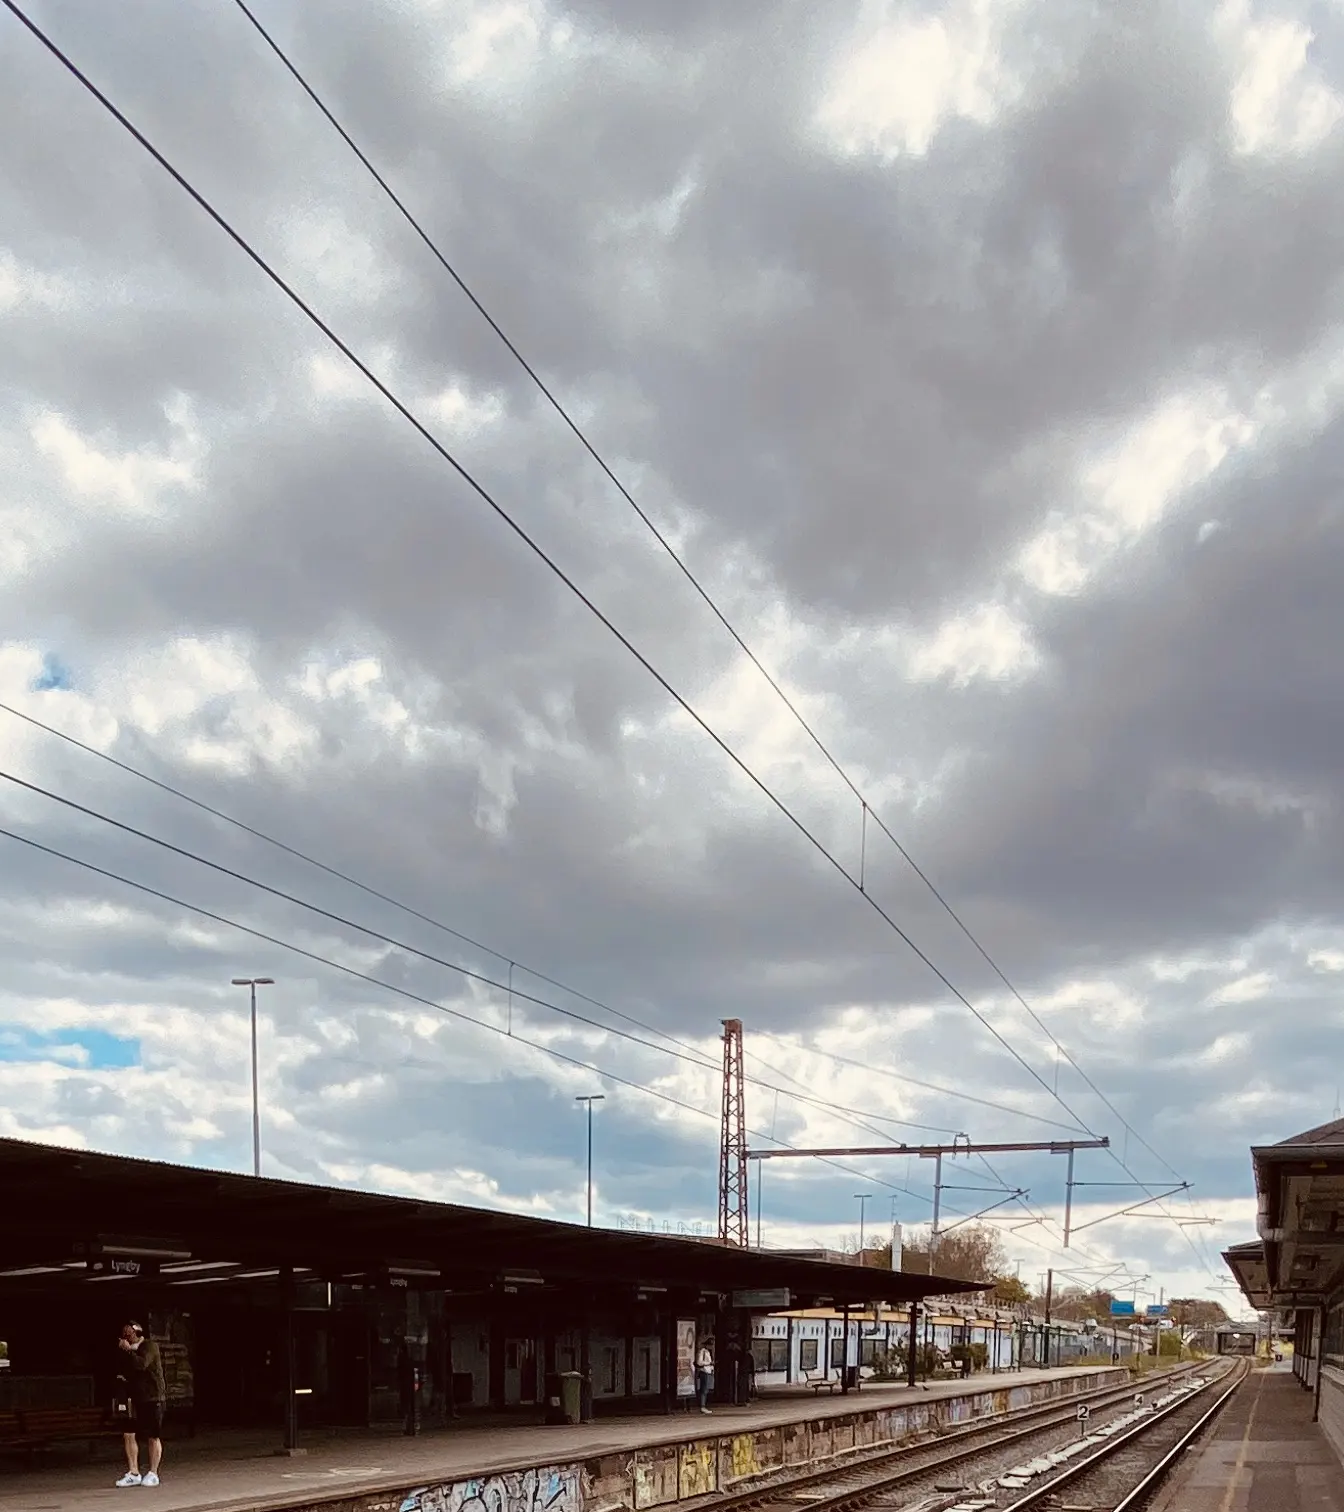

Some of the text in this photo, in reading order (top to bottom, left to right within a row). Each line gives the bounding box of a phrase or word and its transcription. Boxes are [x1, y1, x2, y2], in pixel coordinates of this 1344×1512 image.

[112, 1260, 140, 1274] Lyngby
[1136, 1396, 1143, 1405] 4
[1078, 1405, 1088, 1419] 2
